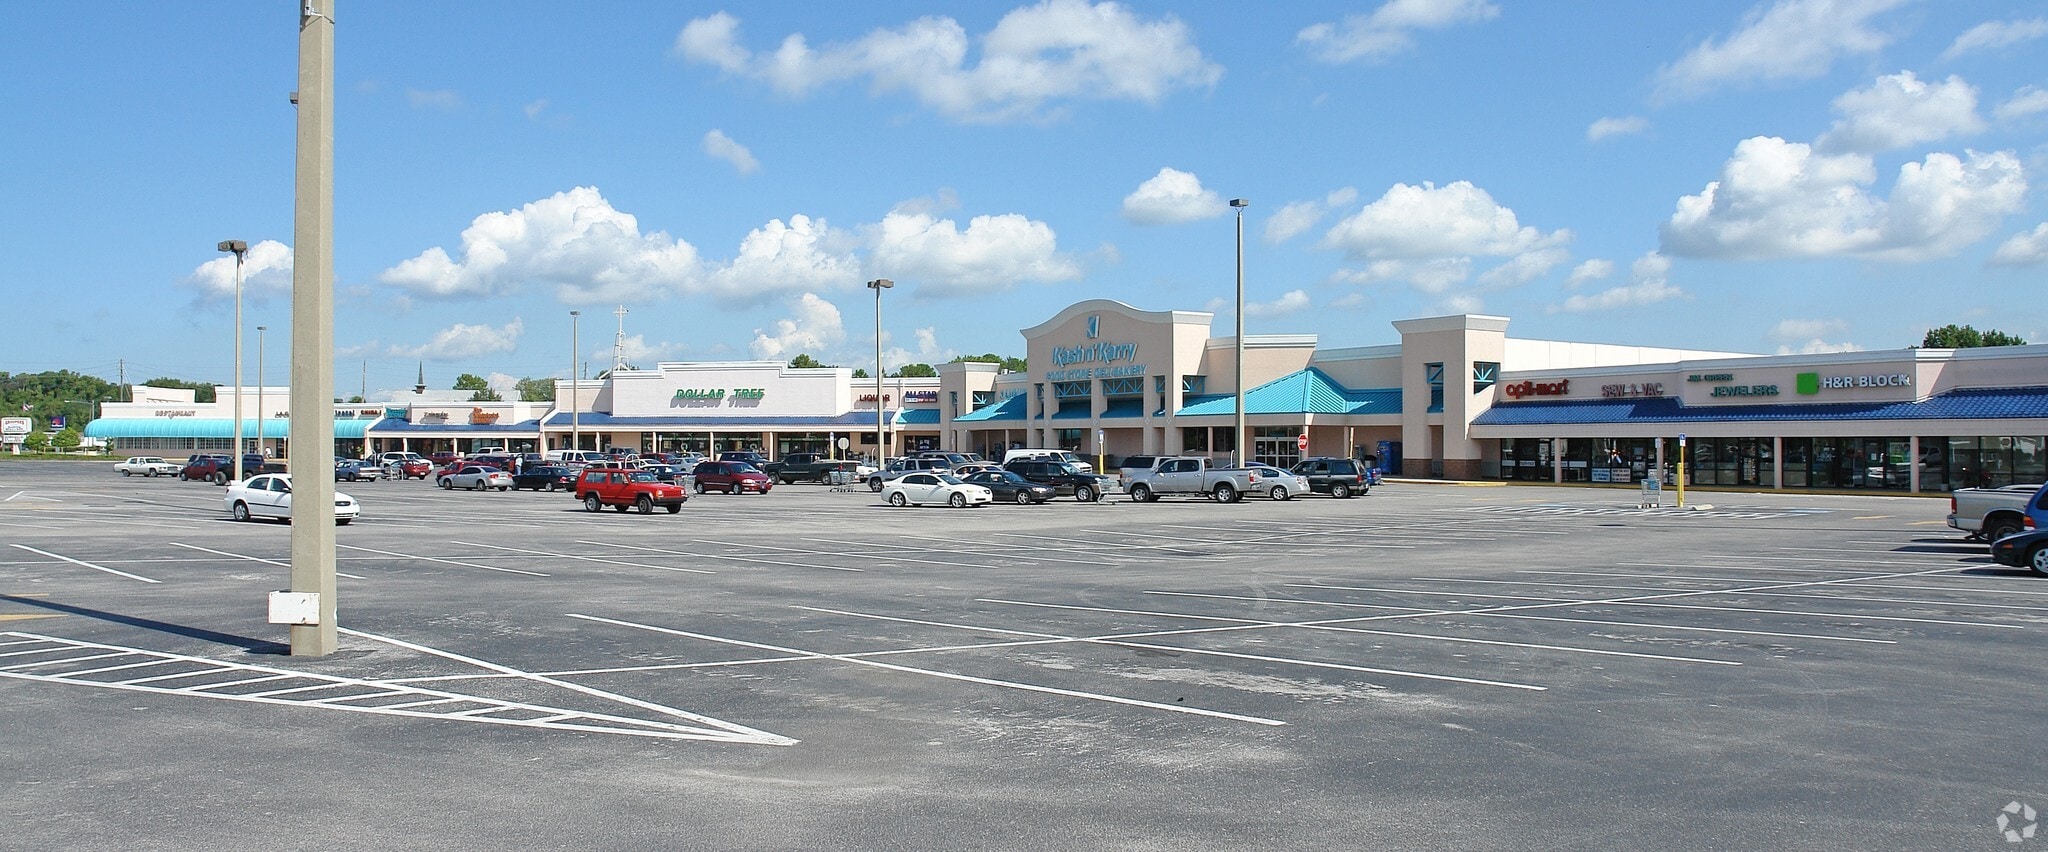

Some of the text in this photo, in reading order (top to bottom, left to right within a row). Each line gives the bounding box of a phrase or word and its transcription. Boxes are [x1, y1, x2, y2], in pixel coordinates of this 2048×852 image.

[1052, 344, 1085, 368] Kash
[1097, 340, 1138, 364] Karry
[1823, 374, 1911, 389] H&R BLOCK
[676, 388, 766, 399] DOLLAR TREE
[1601, 382, 1664, 397] SEW & VAC
[1710, 384, 1780, 398] JEWELERS
[859, 393, 890, 401] LIQUR
